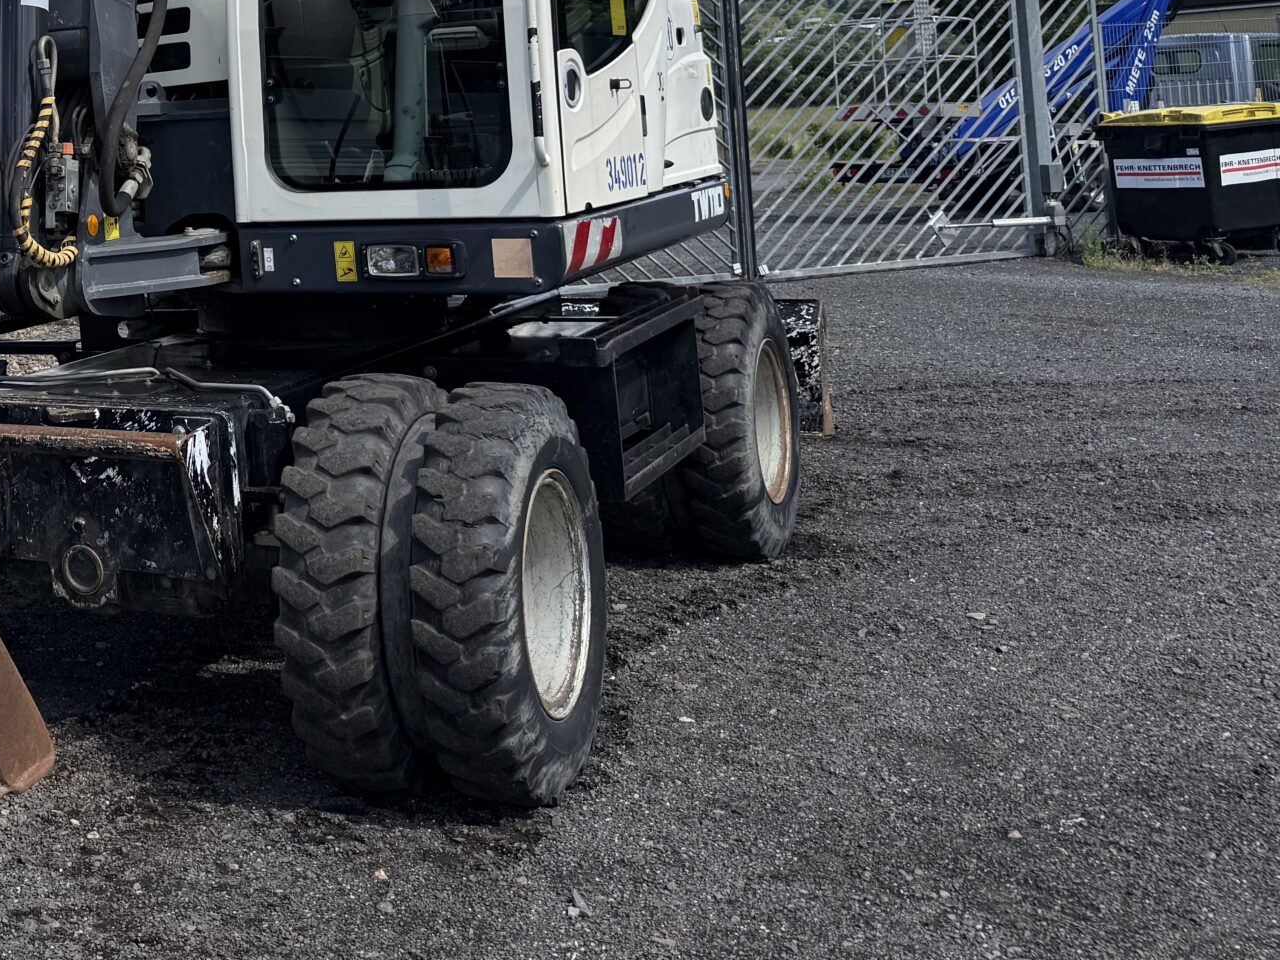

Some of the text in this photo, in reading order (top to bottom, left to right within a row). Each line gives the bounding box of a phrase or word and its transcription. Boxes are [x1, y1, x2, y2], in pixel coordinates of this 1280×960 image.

[1126, 48, 1146, 95] MIETE
[1144, 9, 1160, 40] 23m
[606, 152, 646, 192] 349012
